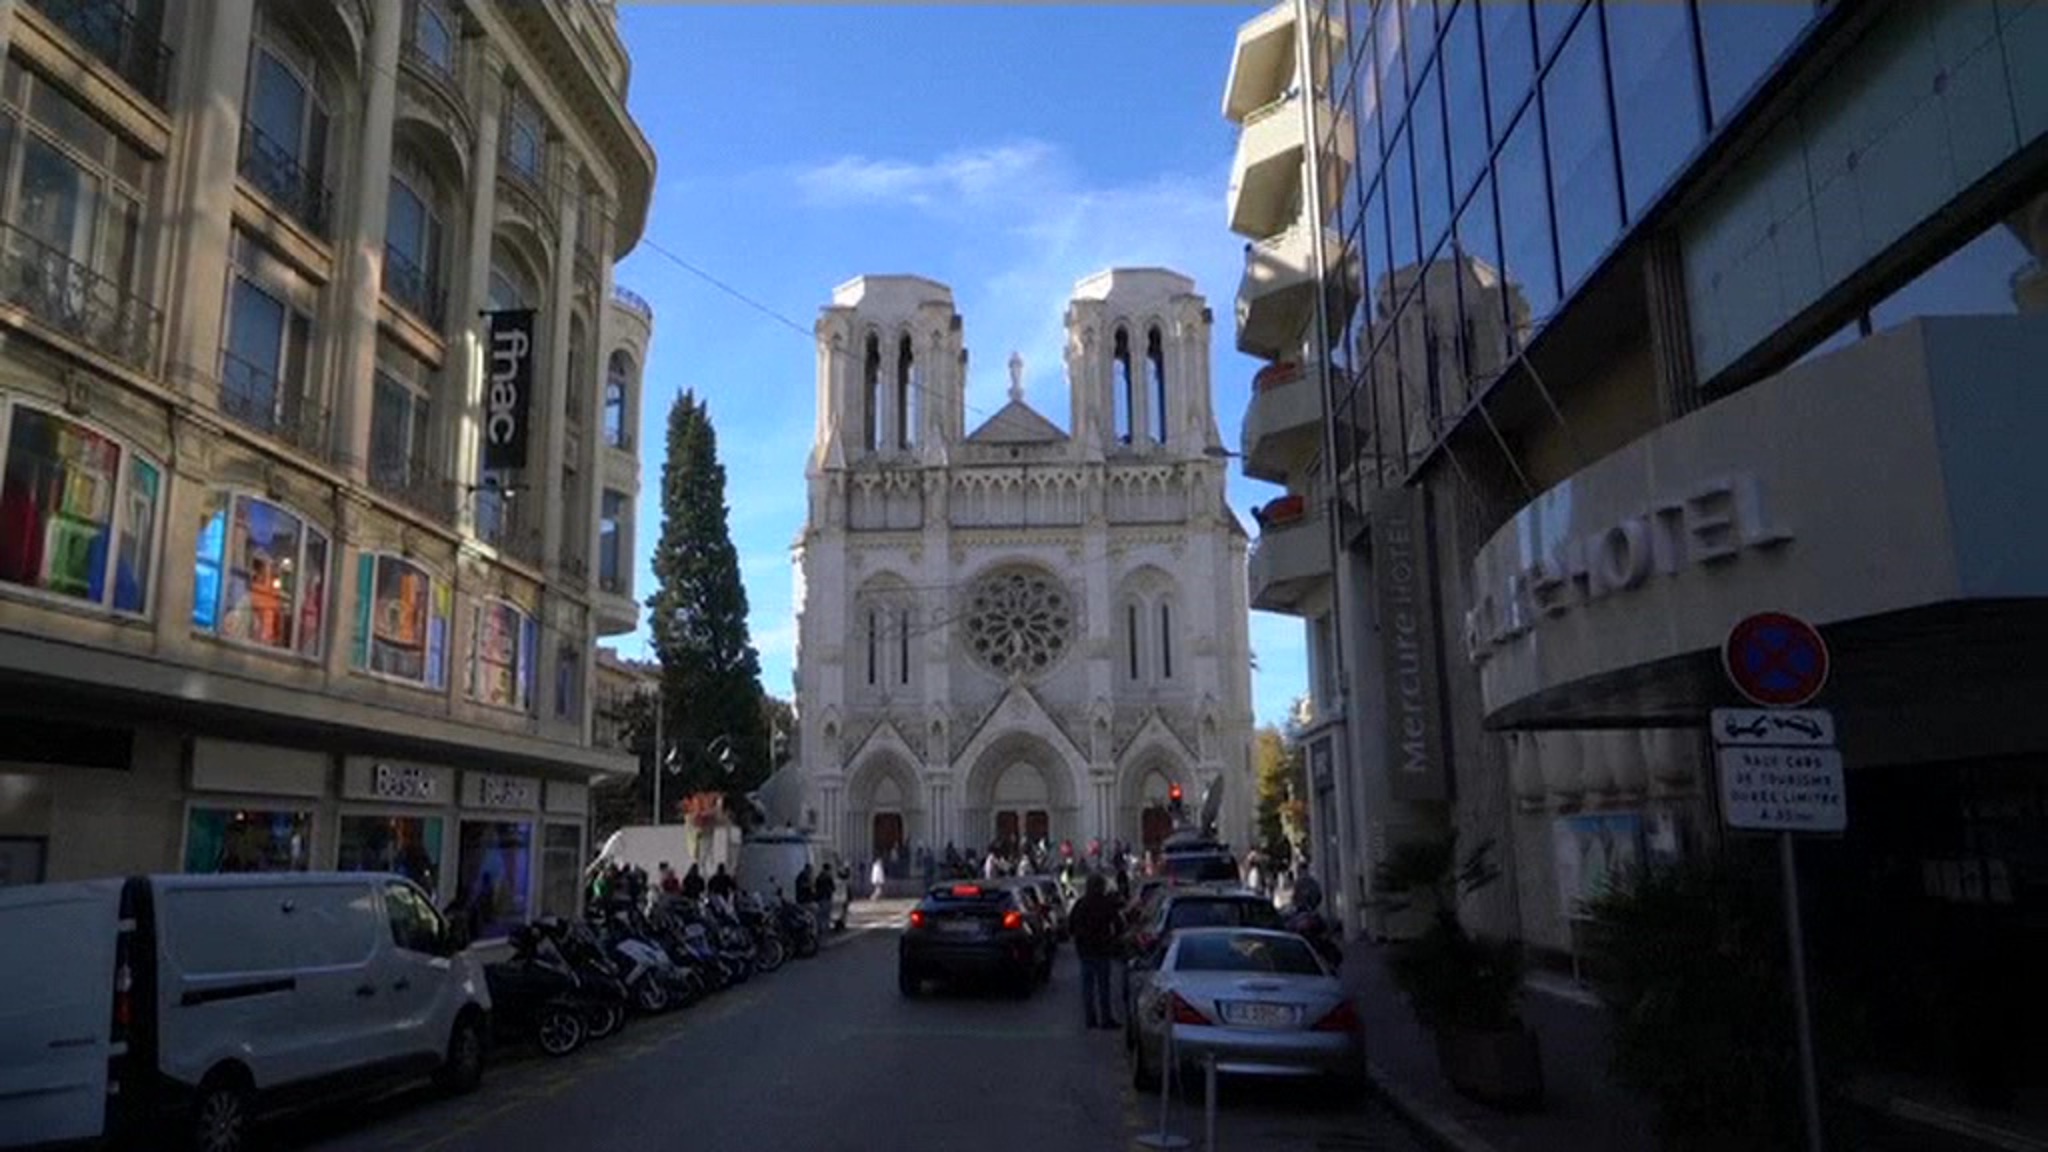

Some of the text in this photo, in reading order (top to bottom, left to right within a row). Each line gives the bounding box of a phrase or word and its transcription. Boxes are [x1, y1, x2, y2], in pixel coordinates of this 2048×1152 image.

[489, 330, 529, 444] fnac
[1567, 475, 1794, 604] HOTEL
[1387, 517, 1427, 773] Mercure HOTEL
[1760, 772, 1832, 786] TOURISME
